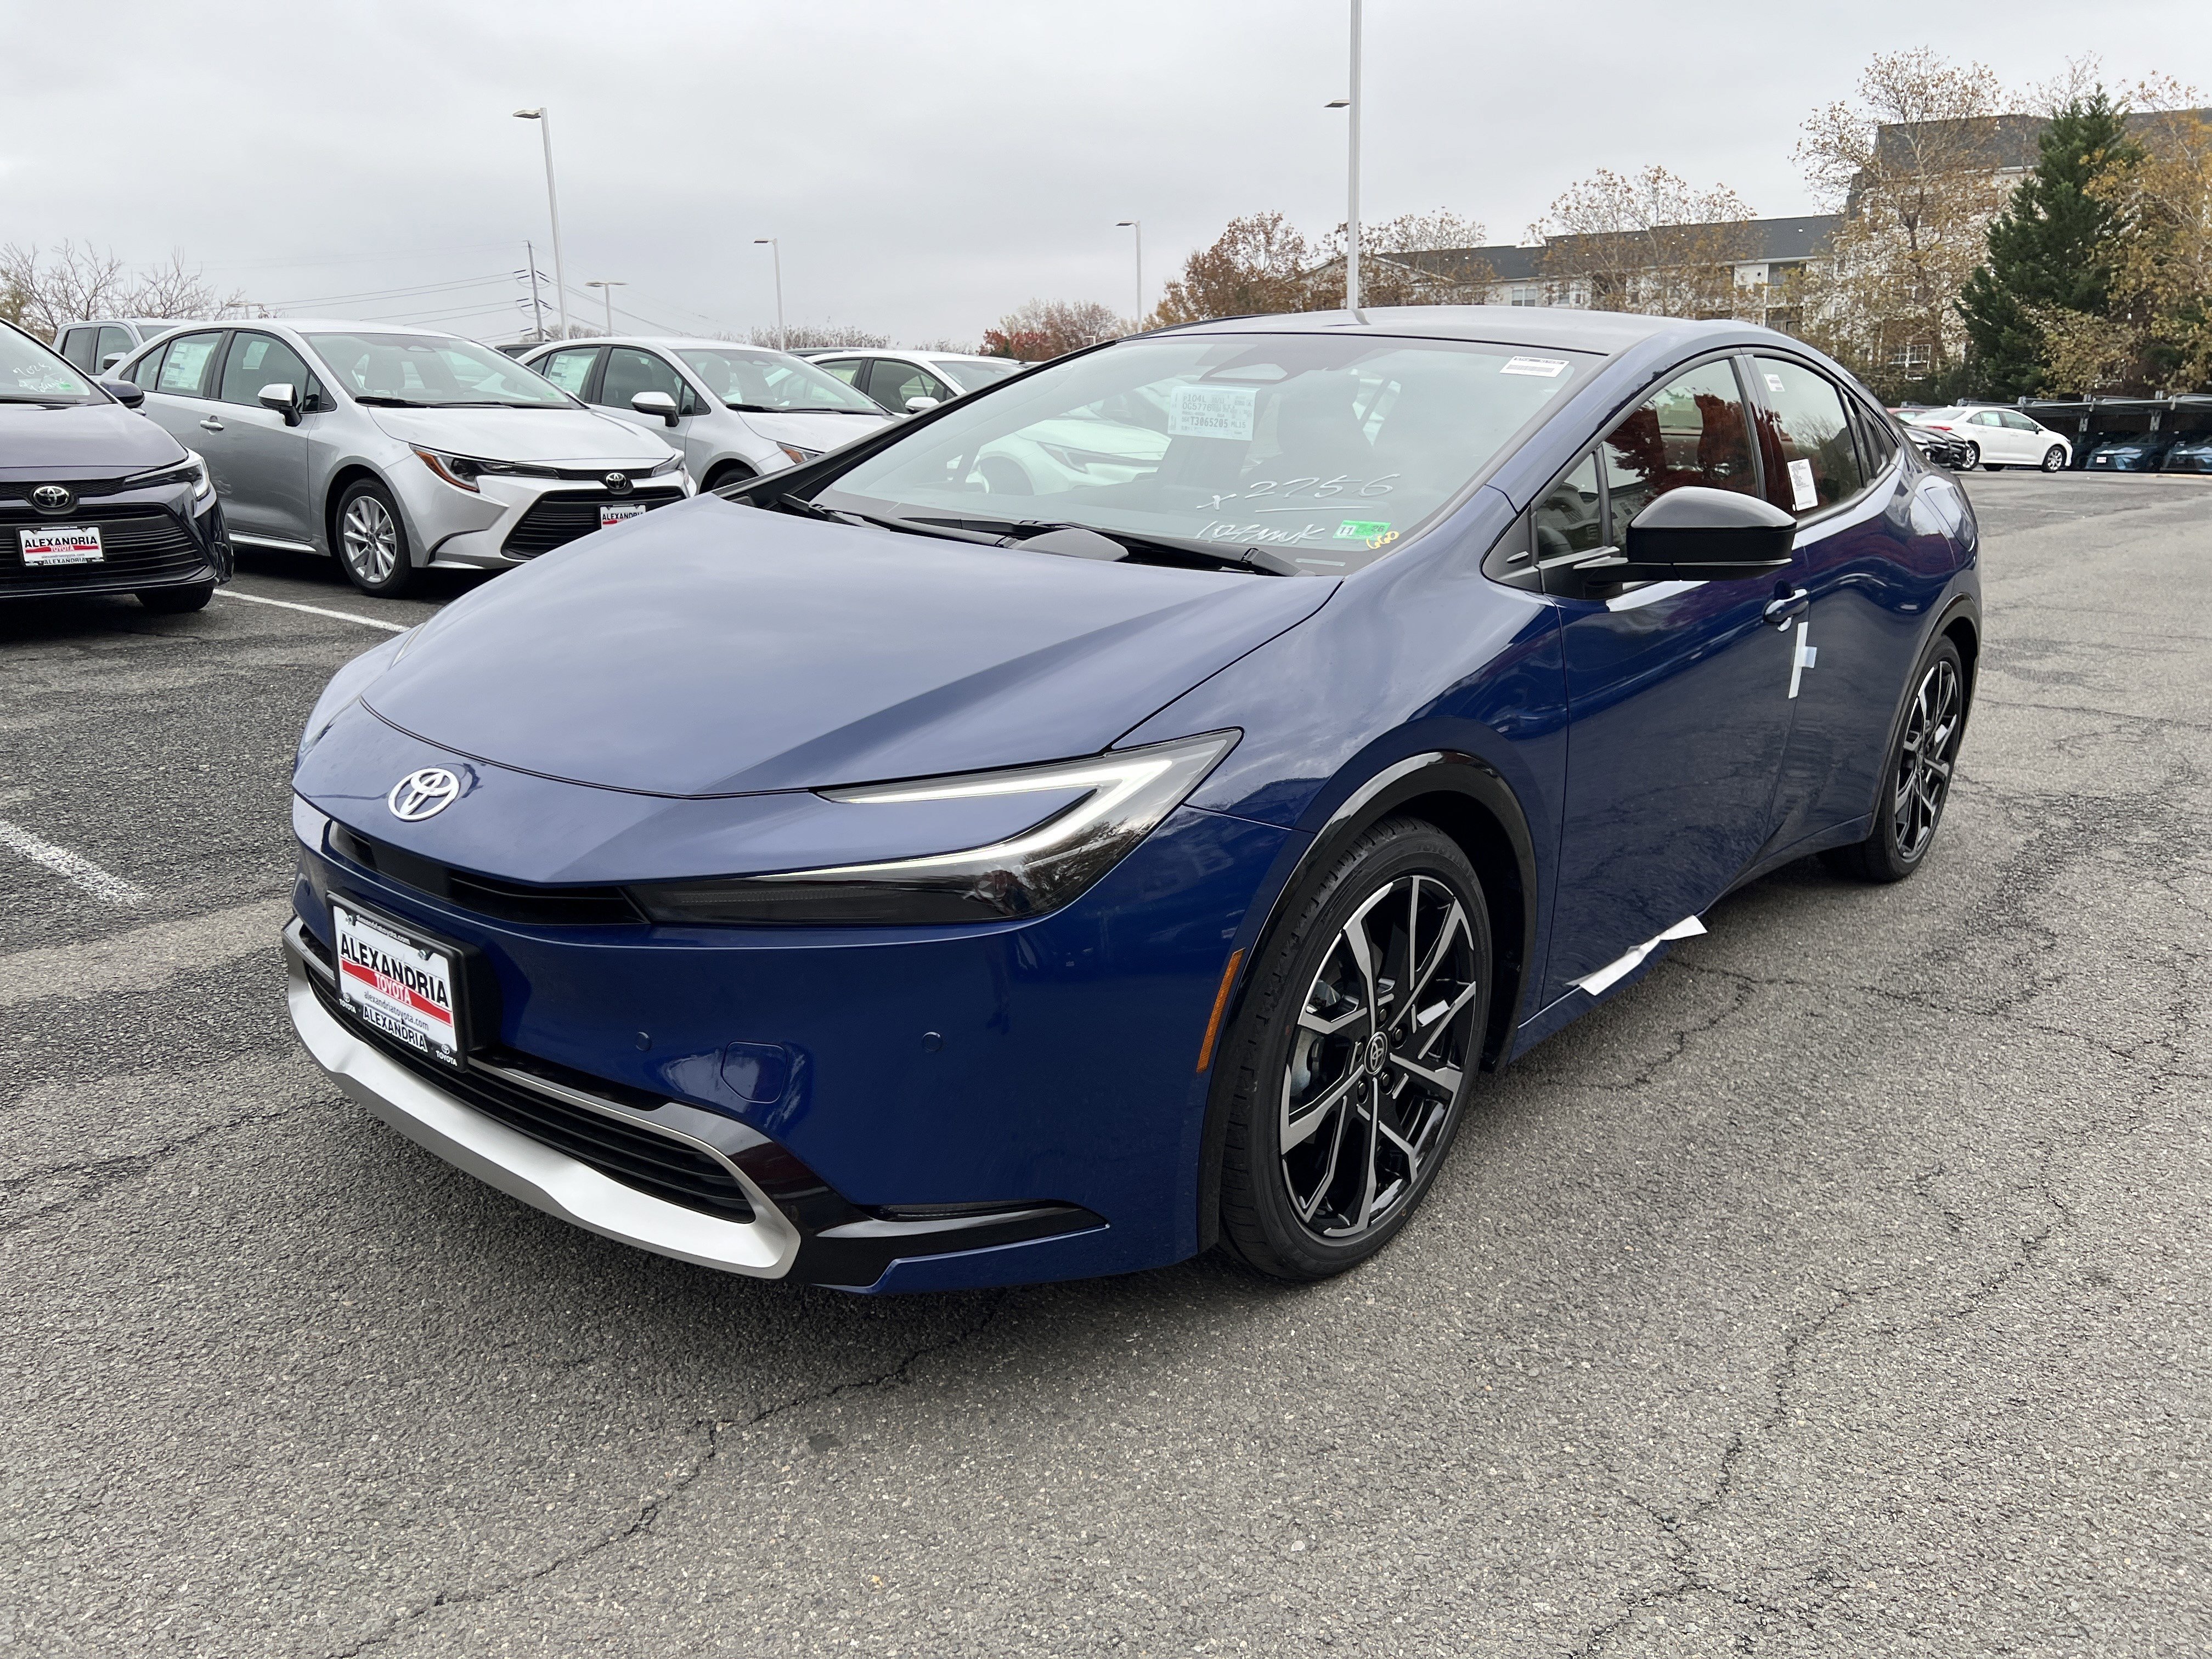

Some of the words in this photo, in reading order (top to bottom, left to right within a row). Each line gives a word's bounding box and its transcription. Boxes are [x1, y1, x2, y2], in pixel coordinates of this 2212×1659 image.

[25, 536, 98, 548] ALEXANDRIA
[44, 557, 86, 565] ALEXANDRIA
[340, 933, 449, 1008] ALEXANDRIA
[374, 972, 412, 1006] TOYOTA
[338, 998, 357, 1014] TOYOTA
[363, 990, 430, 1031] alexandriatoyota.com
[363, 1004, 428, 1053] ALEXANDRIA
[435, 1049, 458, 1066] TOYOTA
